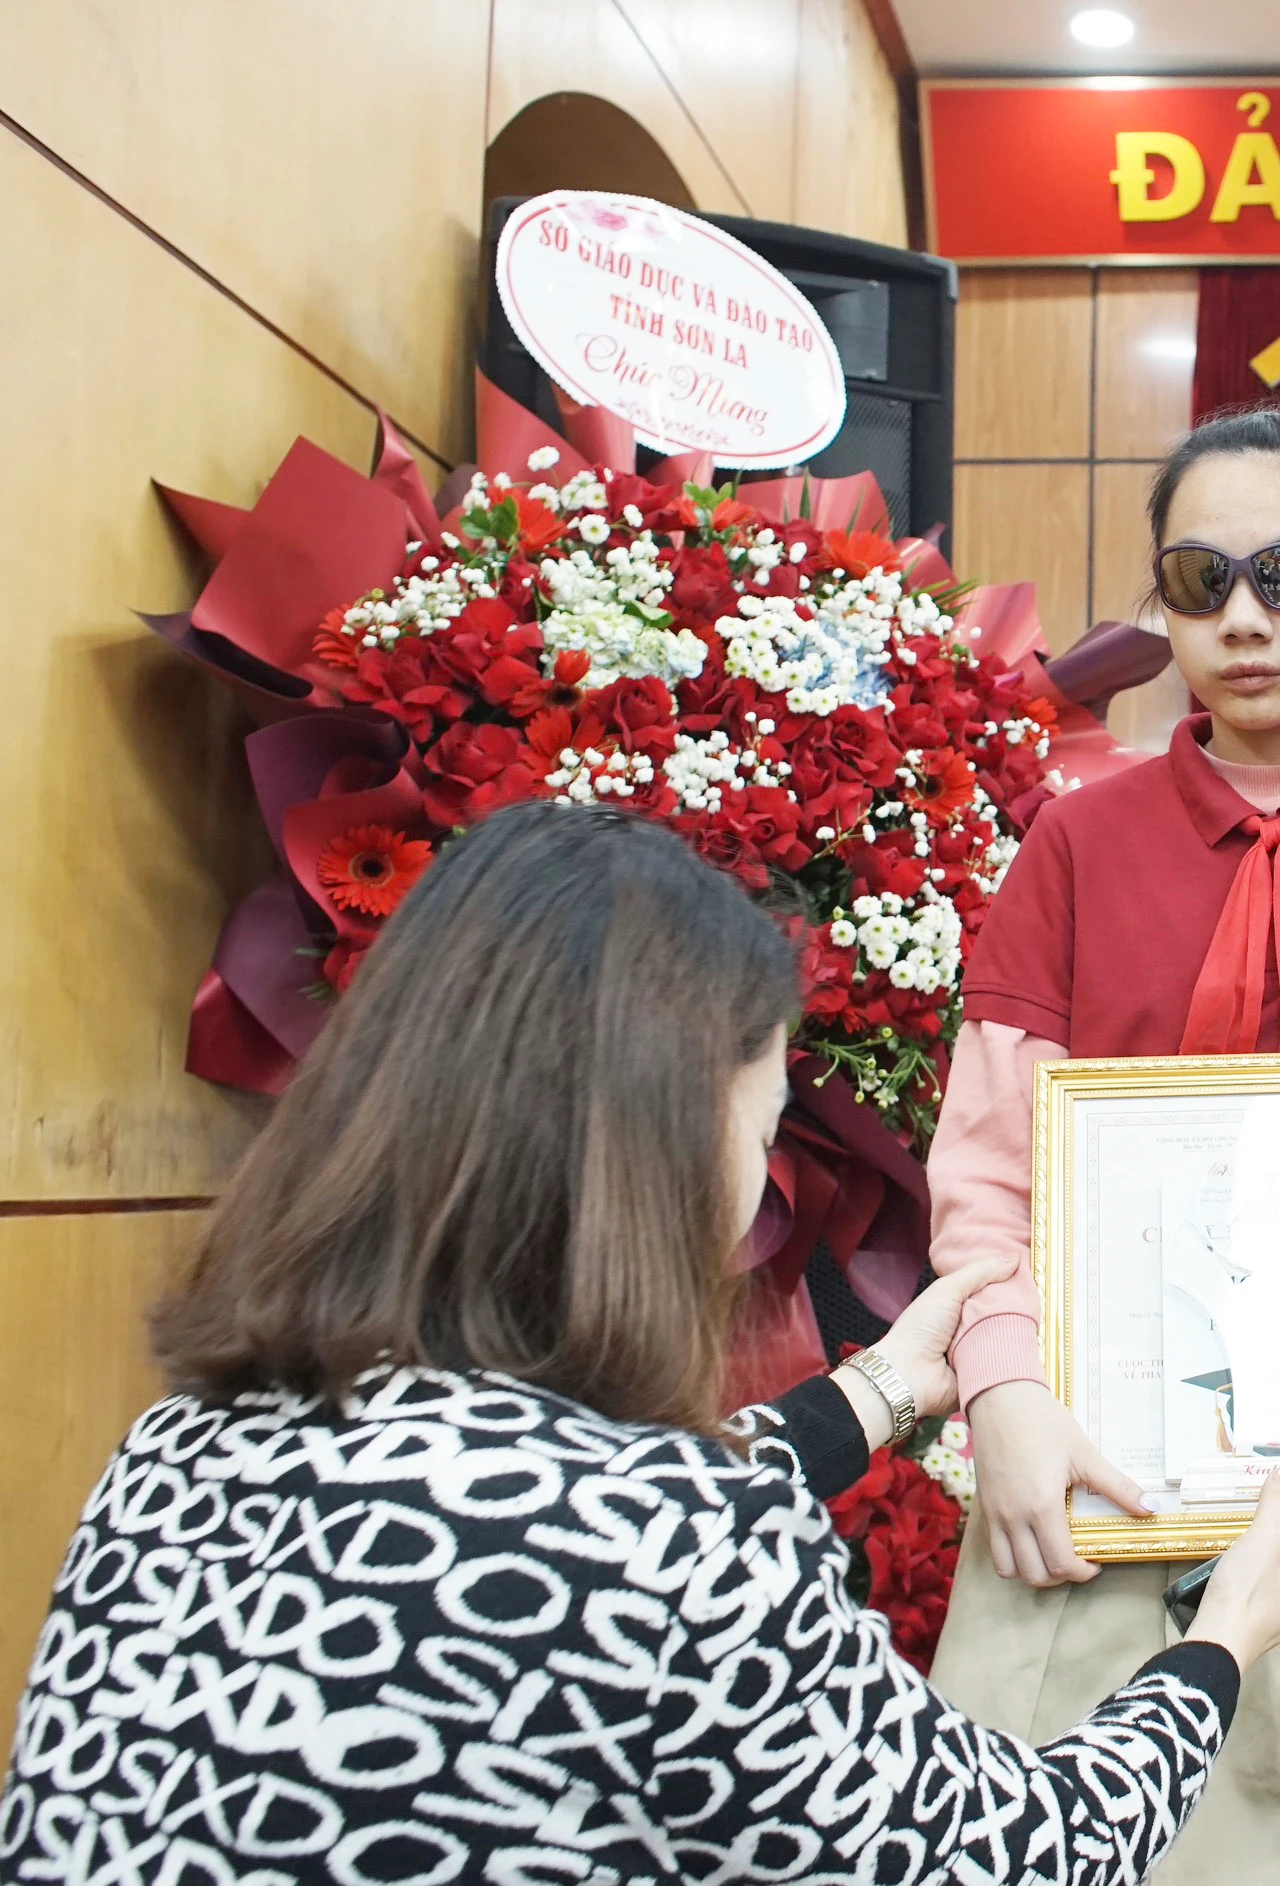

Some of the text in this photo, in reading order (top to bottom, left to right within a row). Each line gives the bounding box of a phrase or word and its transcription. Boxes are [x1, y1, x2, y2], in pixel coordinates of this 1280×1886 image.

[539, 219, 812, 353] SỞ GIÁO DỤC VÀ ĐÀO TẠO
[574, 333, 663, 386] Chúc
[609, 292, 748, 369] TỈNH SƠN LA
[1150, 1358, 1164, 1368] TH
